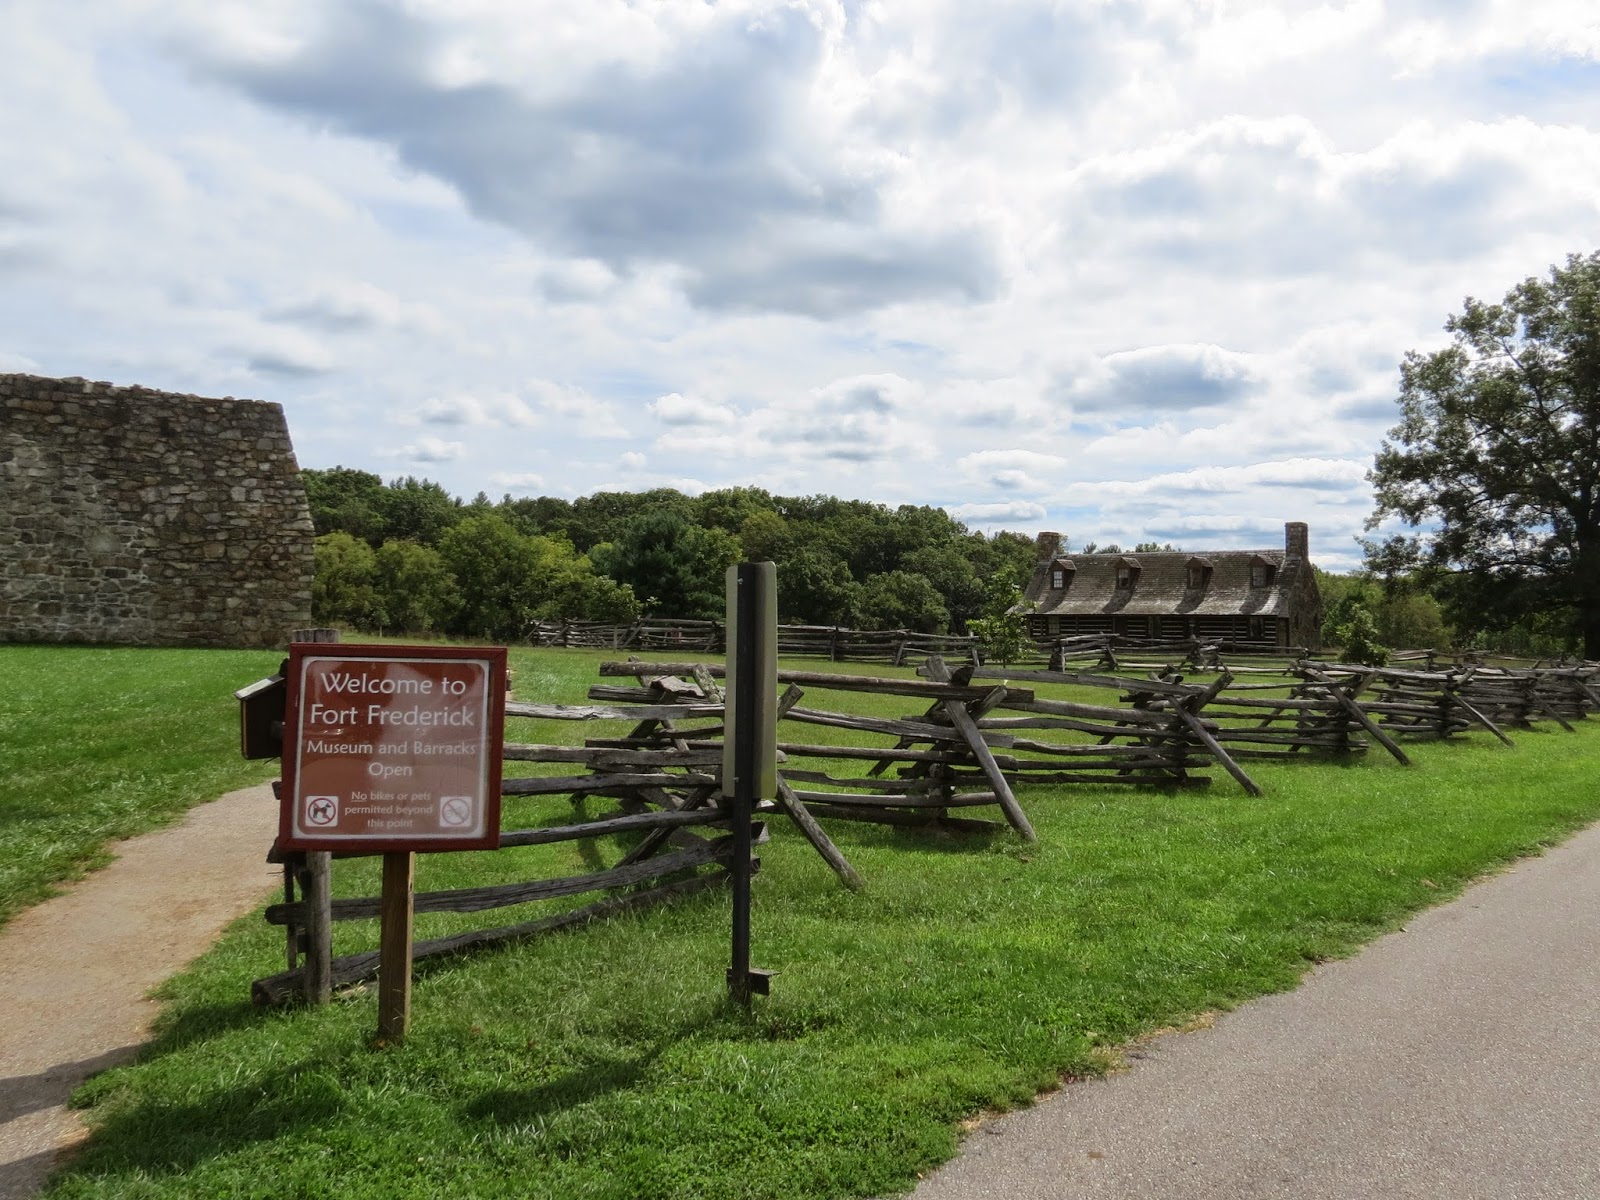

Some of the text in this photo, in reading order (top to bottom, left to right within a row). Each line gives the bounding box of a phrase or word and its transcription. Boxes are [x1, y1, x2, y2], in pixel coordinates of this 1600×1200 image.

[321, 672, 466, 695] Welcome to
[310, 703, 475, 726] Fort Frederick
[307, 740, 476, 755] Museum and Barracks
[368, 762, 412, 779] Open
[351, 791, 431, 802] No bikes or pets
[344, 805, 433, 816] permitted beyond
[367, 819, 413, 830] this point
